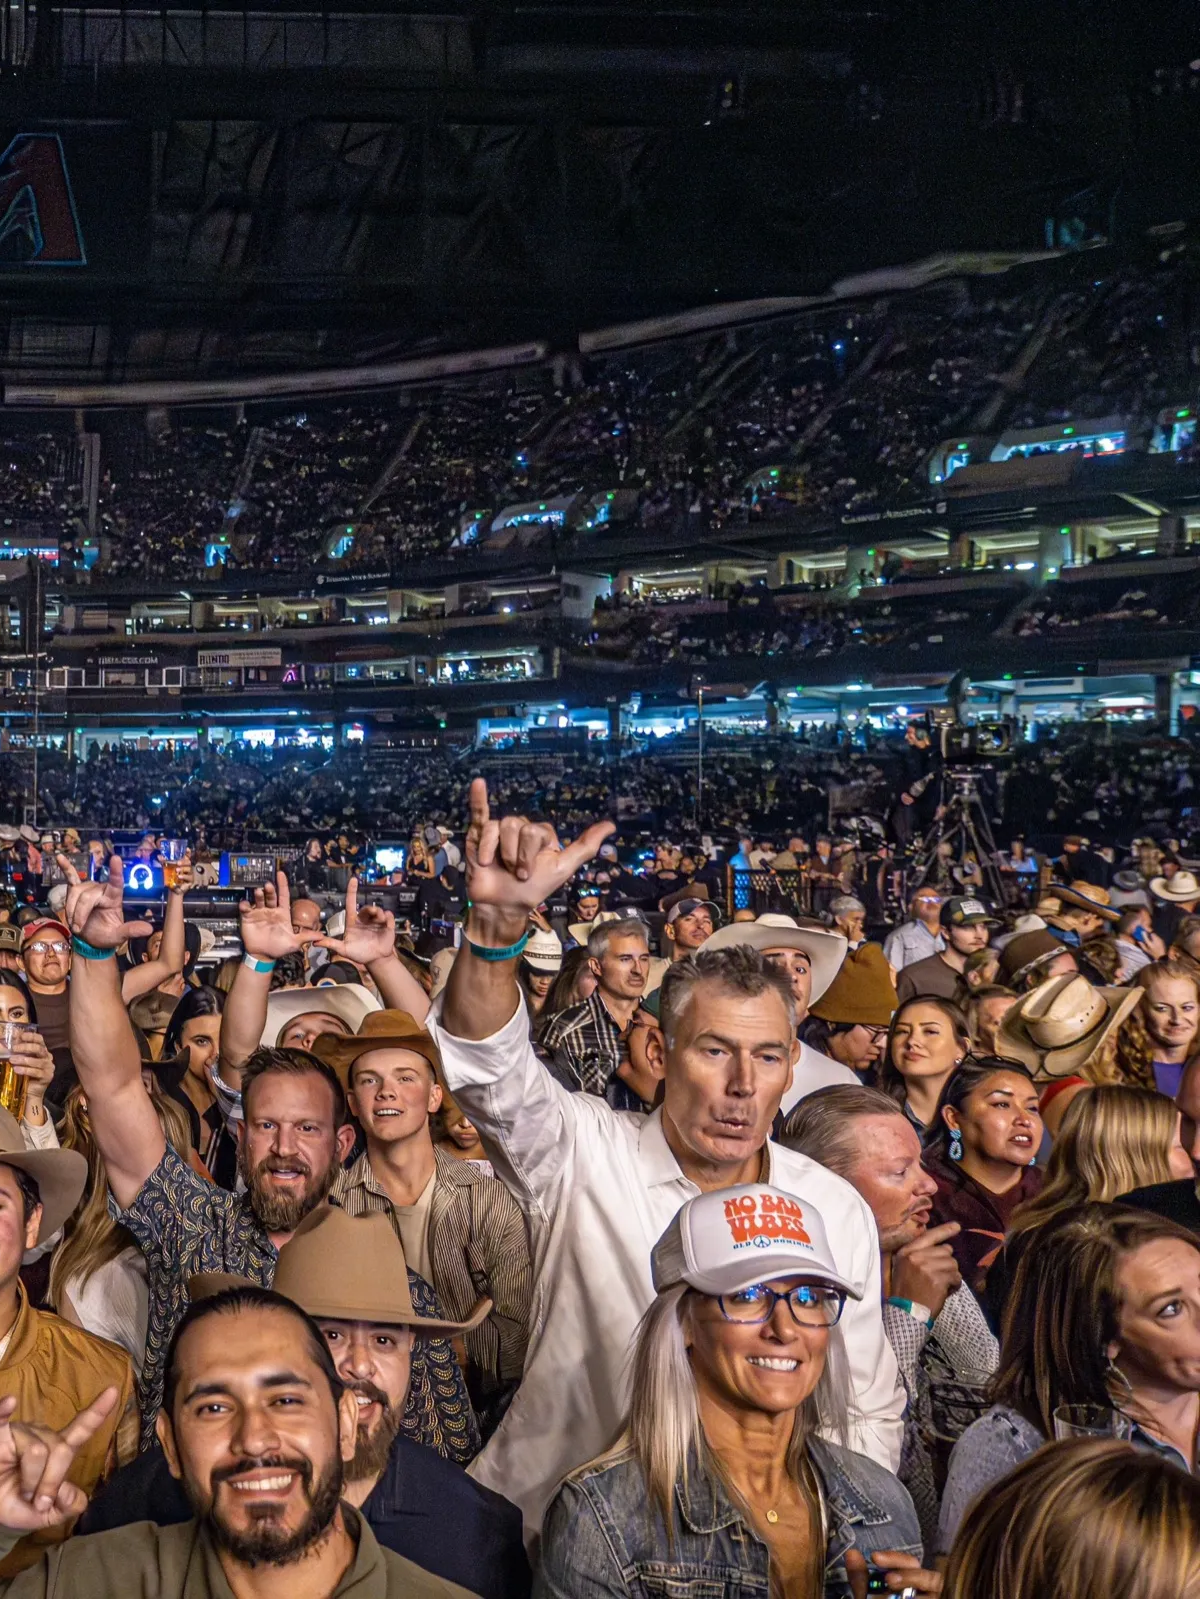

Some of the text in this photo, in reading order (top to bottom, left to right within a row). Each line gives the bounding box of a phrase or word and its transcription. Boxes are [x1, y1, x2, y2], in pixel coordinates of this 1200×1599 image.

[723, 1193, 803, 1220] NO BAD
[726, 1214, 811, 1244] VIBES
